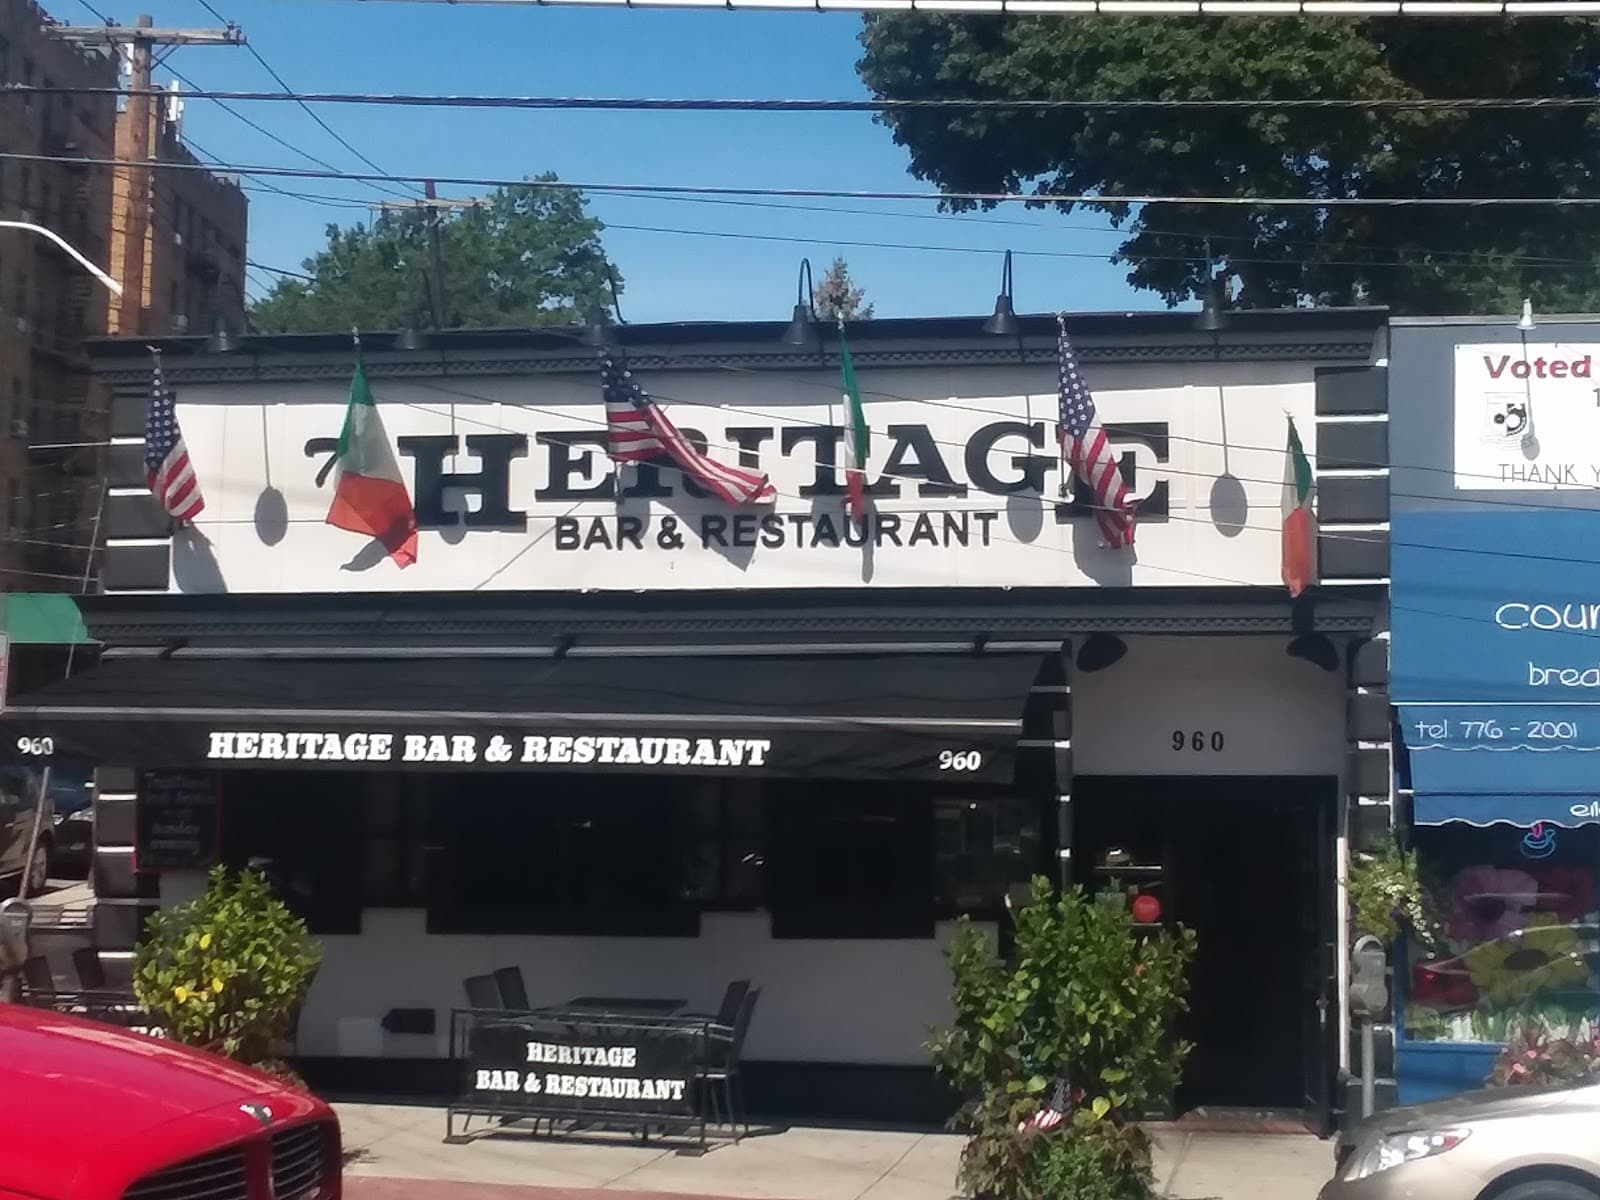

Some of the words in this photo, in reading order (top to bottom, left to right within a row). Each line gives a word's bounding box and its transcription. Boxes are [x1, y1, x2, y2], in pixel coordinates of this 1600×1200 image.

[1483, 354, 1592, 379] Voted
[1497, 463, 1579, 483] THANK
[555, 516, 642, 551] BAR
[656, 515, 685, 550] &
[701, 511, 999, 549] RESTAURANT
[1459, 719, 1504, 739] 776
[1527, 720, 1577, 739] 2001
[17, 736, 54, 755] 960
[207, 731, 393, 761] HERITAGE
[402, 734, 477, 763] BAR
[484, 735, 512, 762] &
[520, 735, 770, 766] RESTAURANT
[1171, 730, 1224, 752] 960
[938, 749, 982, 771] 960
[526, 1041, 636, 1068] HERITAGE
[475, 1069, 520, 1091] BAR
[523, 1072, 542, 1094] &
[545, 1073, 685, 1100] RESTAURANT
